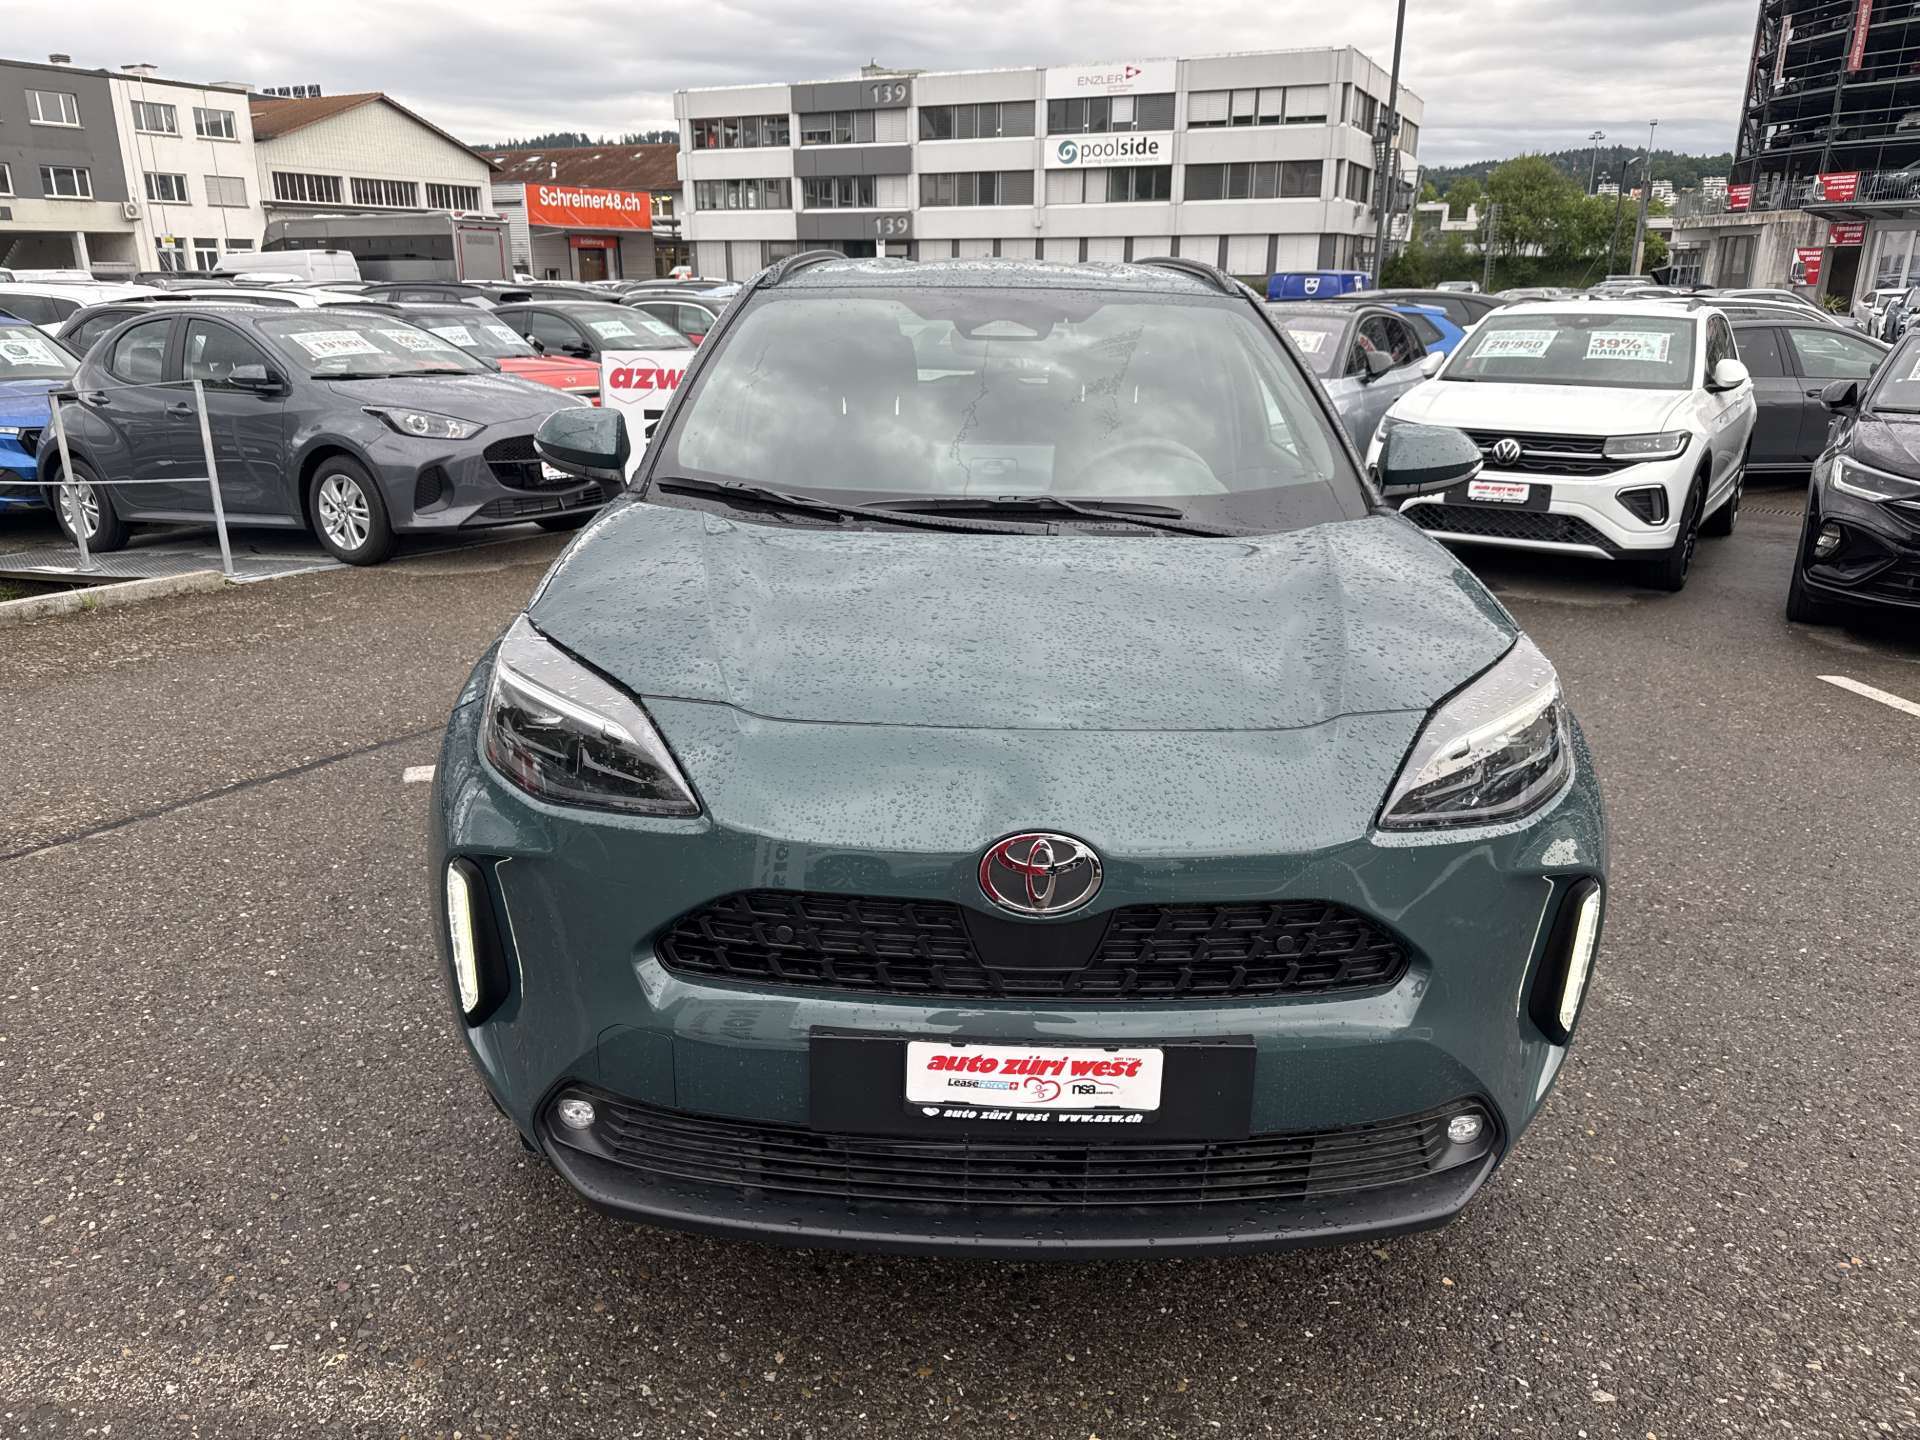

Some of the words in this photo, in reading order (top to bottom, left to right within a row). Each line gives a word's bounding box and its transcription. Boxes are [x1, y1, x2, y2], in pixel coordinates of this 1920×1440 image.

[1077, 74, 1124, 87] ENZLER
[870, 84, 907, 103] 139
[1080, 137, 1159, 164] poolside
[539, 186, 640, 212] Schreiner48.ch
[873, 217, 909, 235] 139
[1591, 338, 1641, 349] 39%
[609, 367, 686, 390] azw
[927, 1054, 999, 1074] auto
[999, 1056, 1068, 1076] züri
[1070, 1058, 1143, 1077] west
[1072, 1084, 1096, 1095] nsa
[943, 1109, 976, 1119] auto
[980, 1110, 1012, 1121] züri
[1016, 1112, 1050, 1122] west
[1058, 1112, 1144, 1124] www.azw.ch
